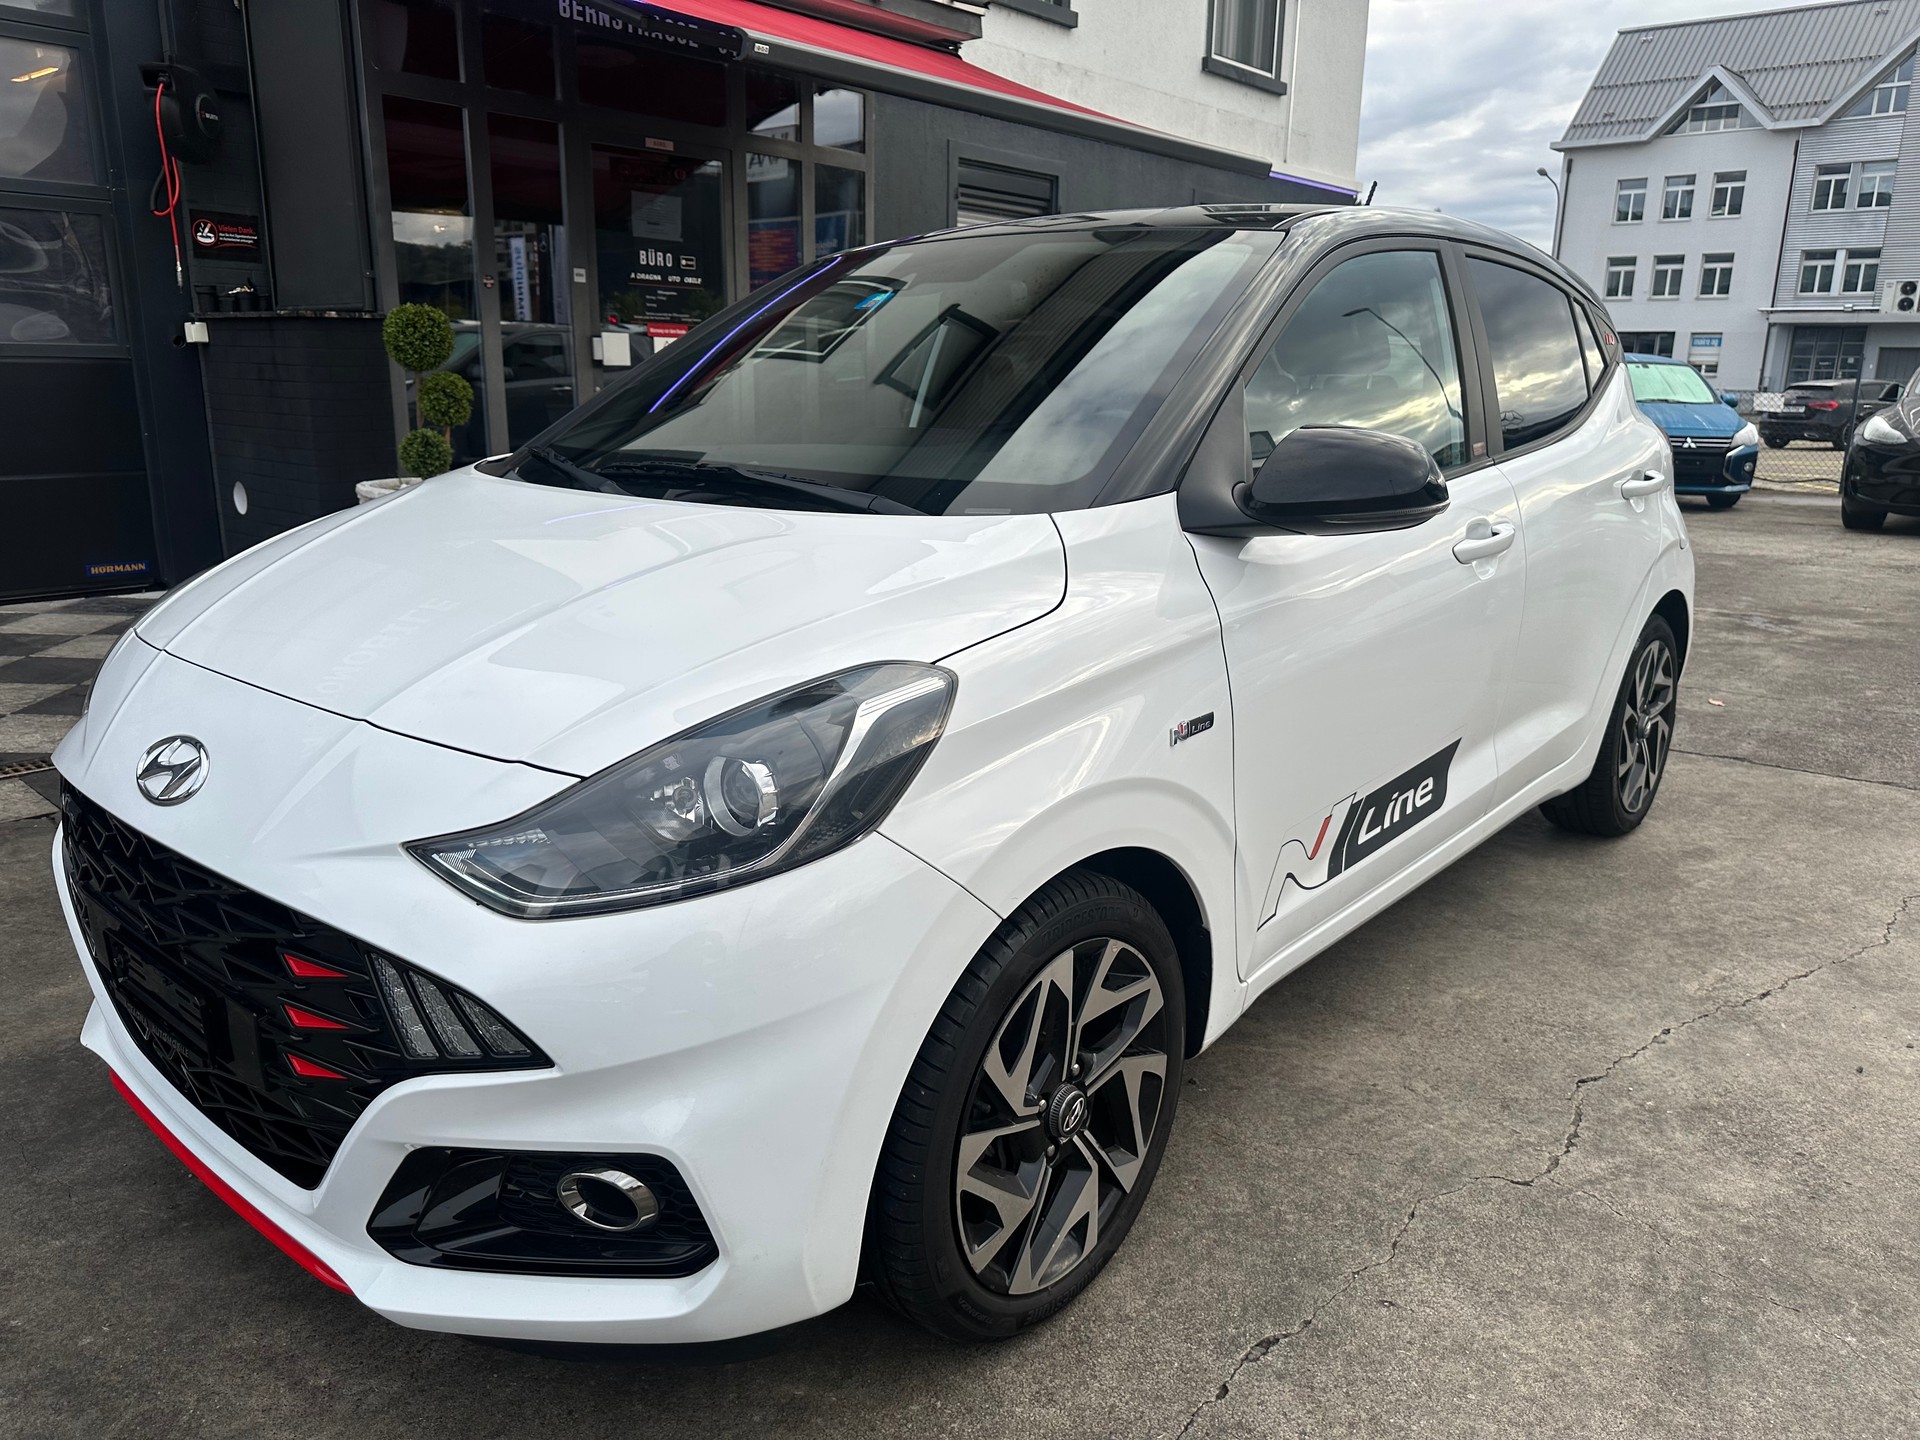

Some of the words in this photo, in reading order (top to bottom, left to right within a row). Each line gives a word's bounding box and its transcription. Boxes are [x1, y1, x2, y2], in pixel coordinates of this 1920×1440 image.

[639, 249, 673, 268] BÜRO
[1191, 721, 1211, 734] Line
[1357, 776, 1434, 845] Line
